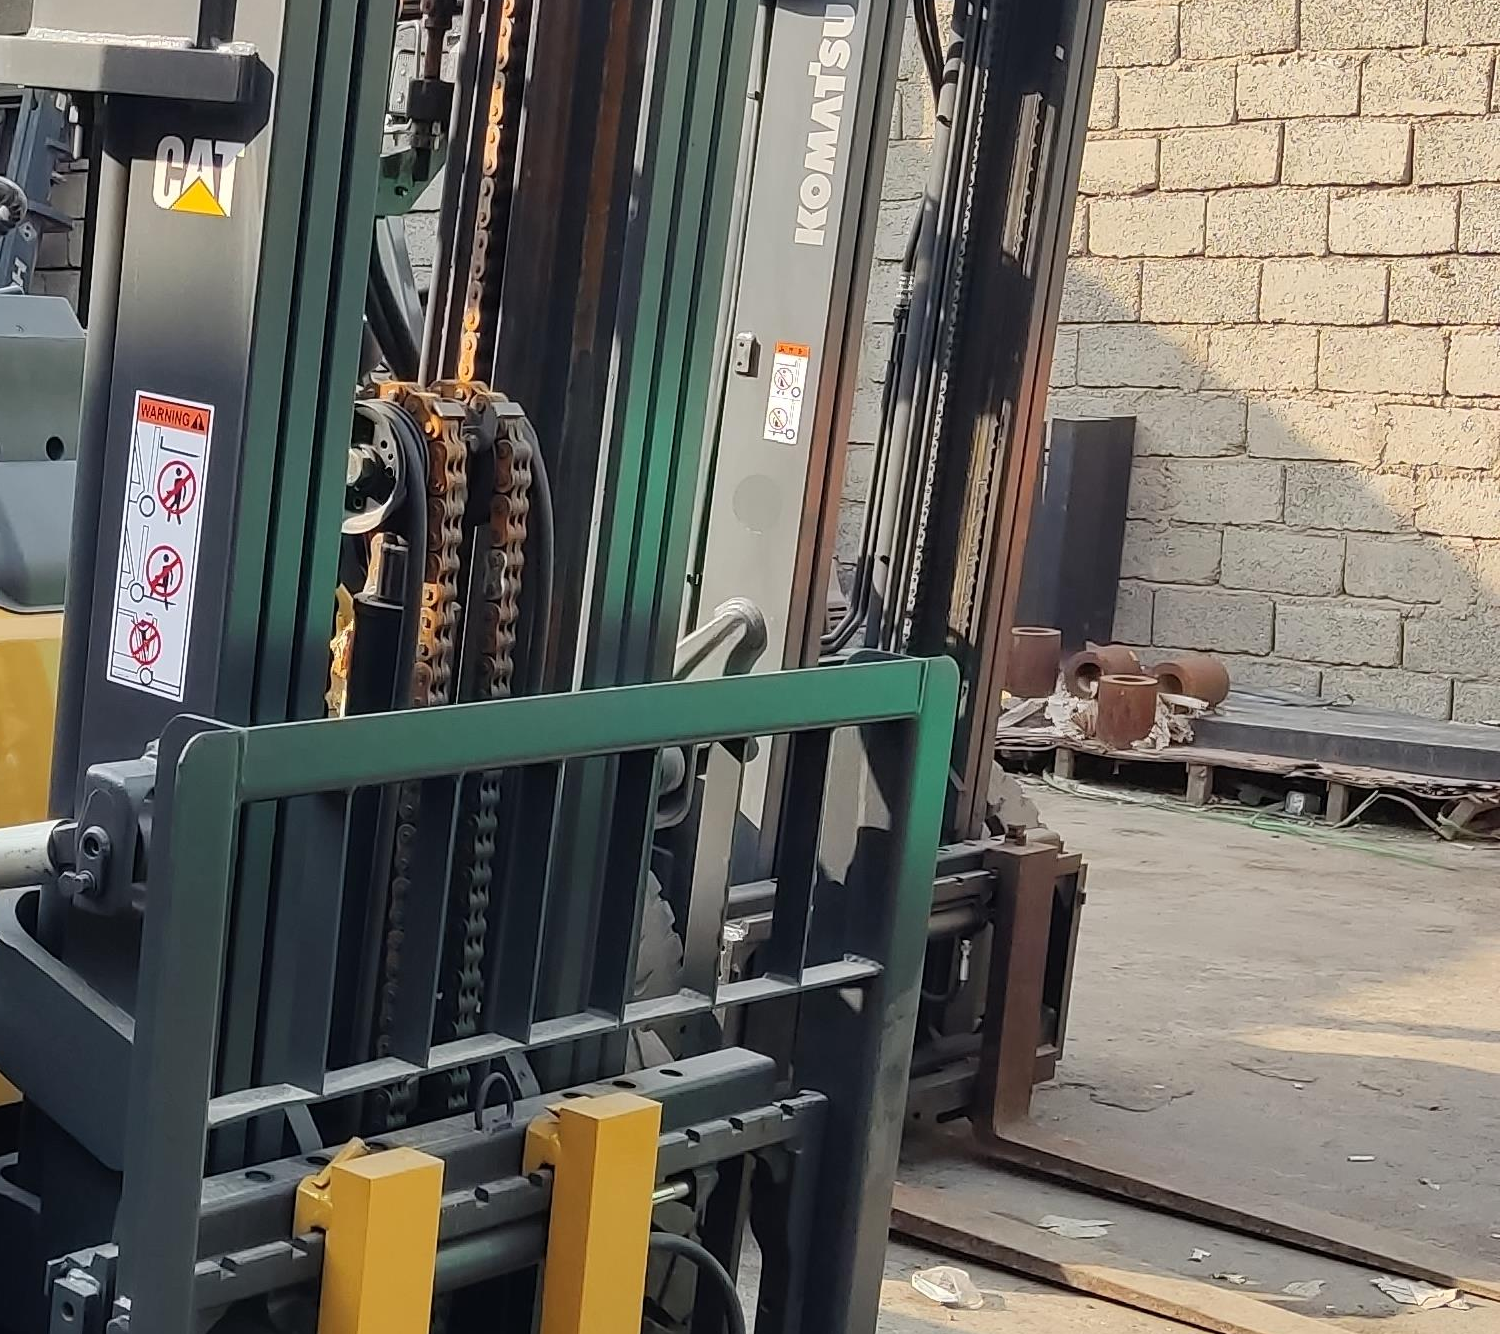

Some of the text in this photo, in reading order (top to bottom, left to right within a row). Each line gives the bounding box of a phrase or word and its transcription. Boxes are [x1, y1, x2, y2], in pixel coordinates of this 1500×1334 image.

[794, 3, 856, 246] KOMATSU
[152, 135, 246, 218] CAT
[141, 403, 190, 427] WARNING
